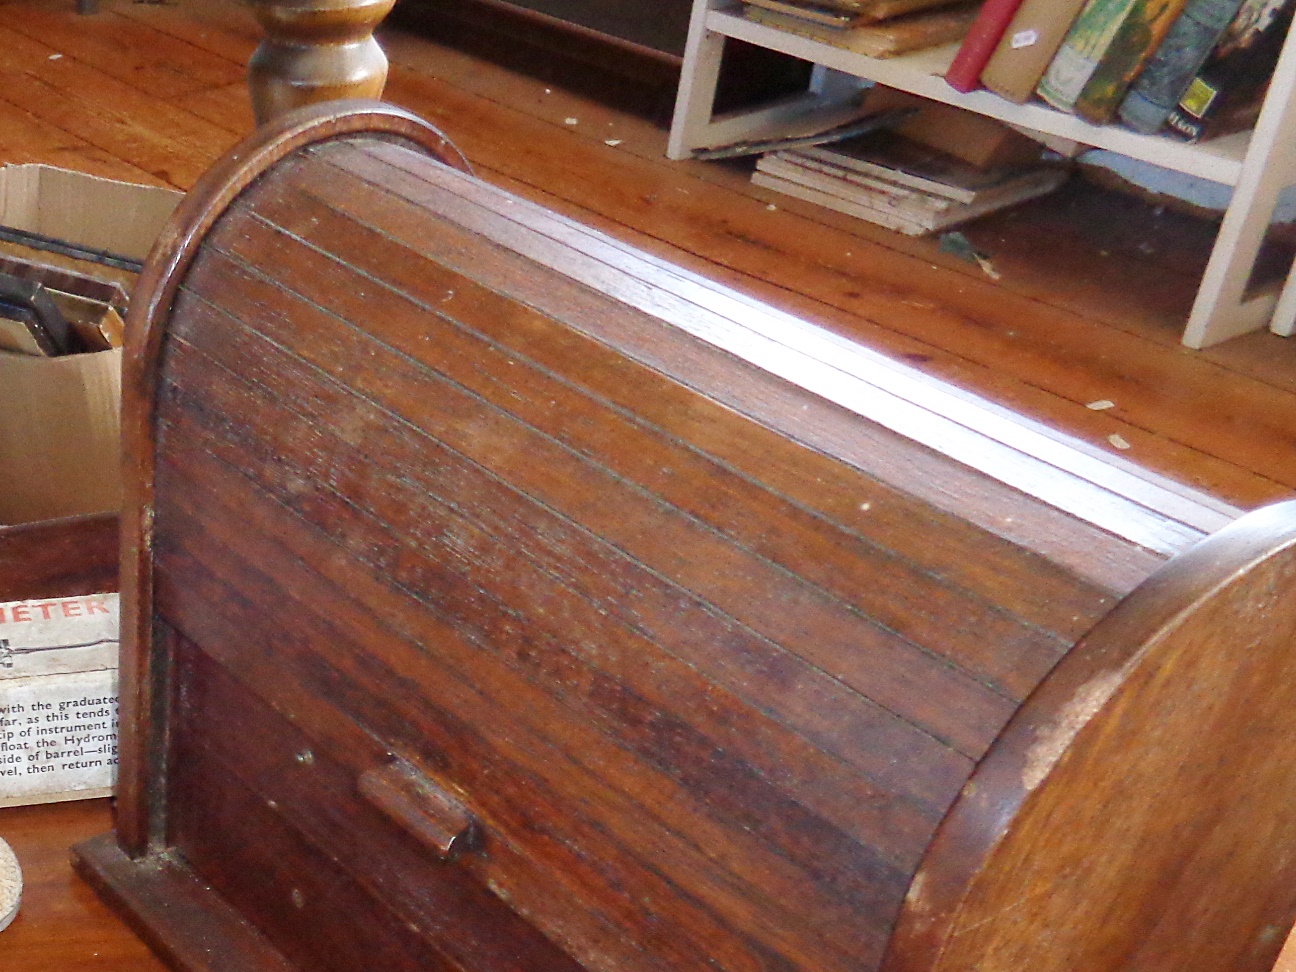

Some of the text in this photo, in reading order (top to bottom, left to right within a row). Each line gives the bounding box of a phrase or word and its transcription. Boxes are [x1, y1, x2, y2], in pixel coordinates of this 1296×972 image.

[32, 701, 52, 711] the
[0, 716, 22, 727] far,
[46, 712, 70, 722] this
[76, 708, 110, 719] tends
[19, 728, 32, 737] of
[37, 722, 108, 735] instrument
[1, 742, 29, 751] float
[37, 739, 57, 748] the
[64, 733, 117, 747] Hydrom
[28, 752, 41, 761] of
[45, 743, 119, 759] barrel—slig
[27, 764, 55, 774] then
[62, 759, 102, 770] return
[107, 757, 119, 766] ac
